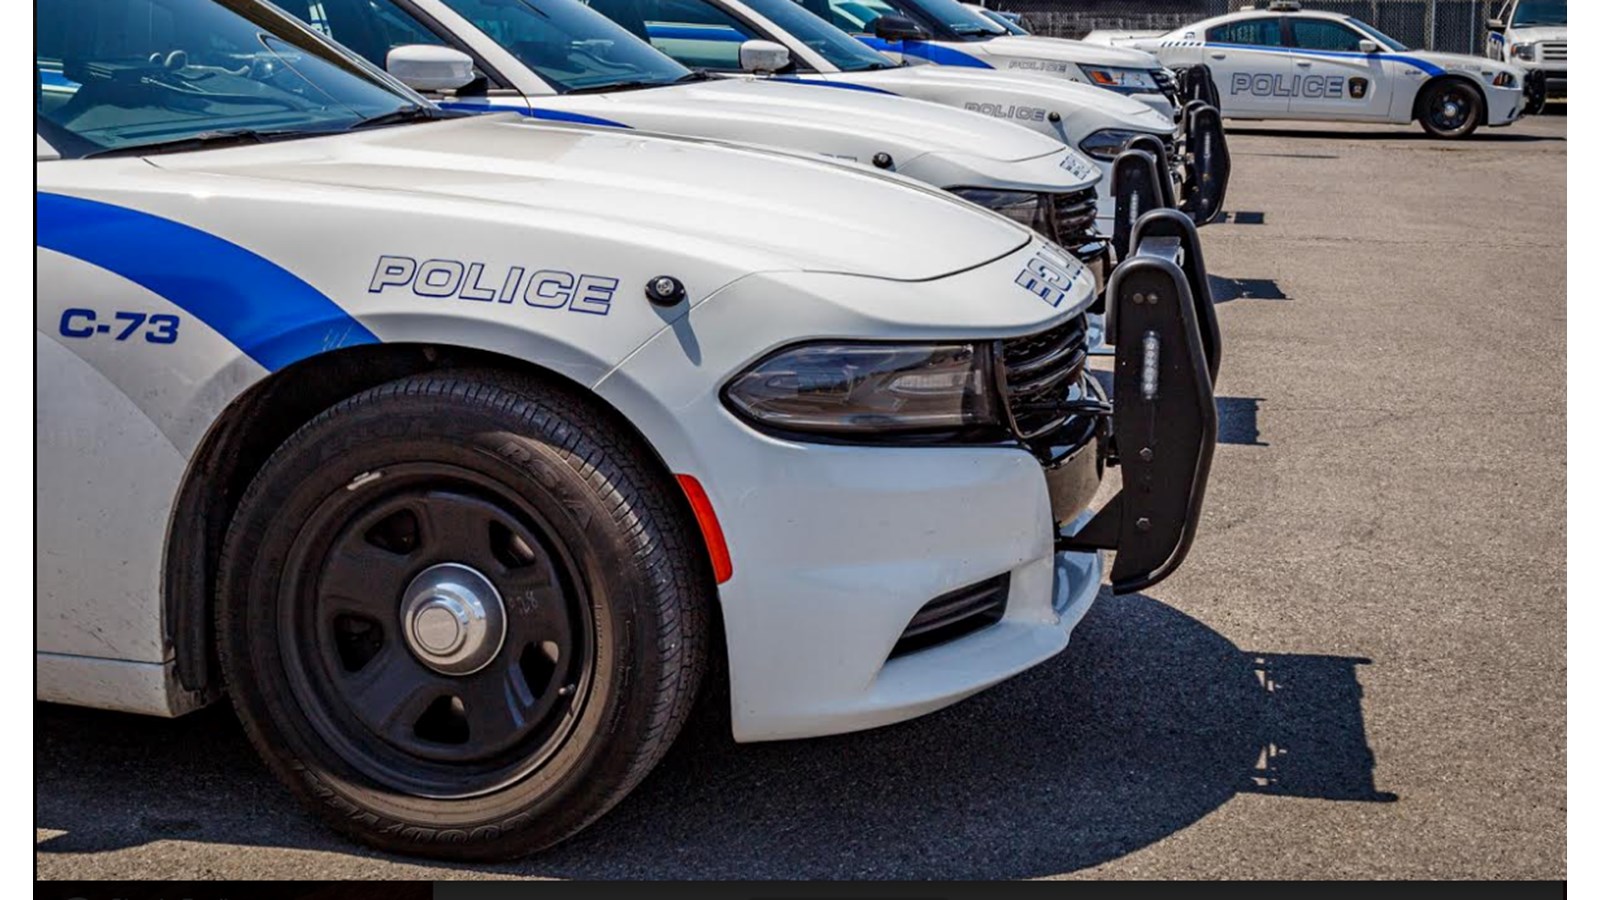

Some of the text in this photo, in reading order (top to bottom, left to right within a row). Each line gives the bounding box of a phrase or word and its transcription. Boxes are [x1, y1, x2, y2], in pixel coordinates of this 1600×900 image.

[1008, 60, 1067, 73] POLICE
[1230, 72, 1343, 99] POLICE
[964, 102, 1046, 122] POLICE
[368, 254, 620, 315] POLICE
[59, 306, 181, 346] C-73
